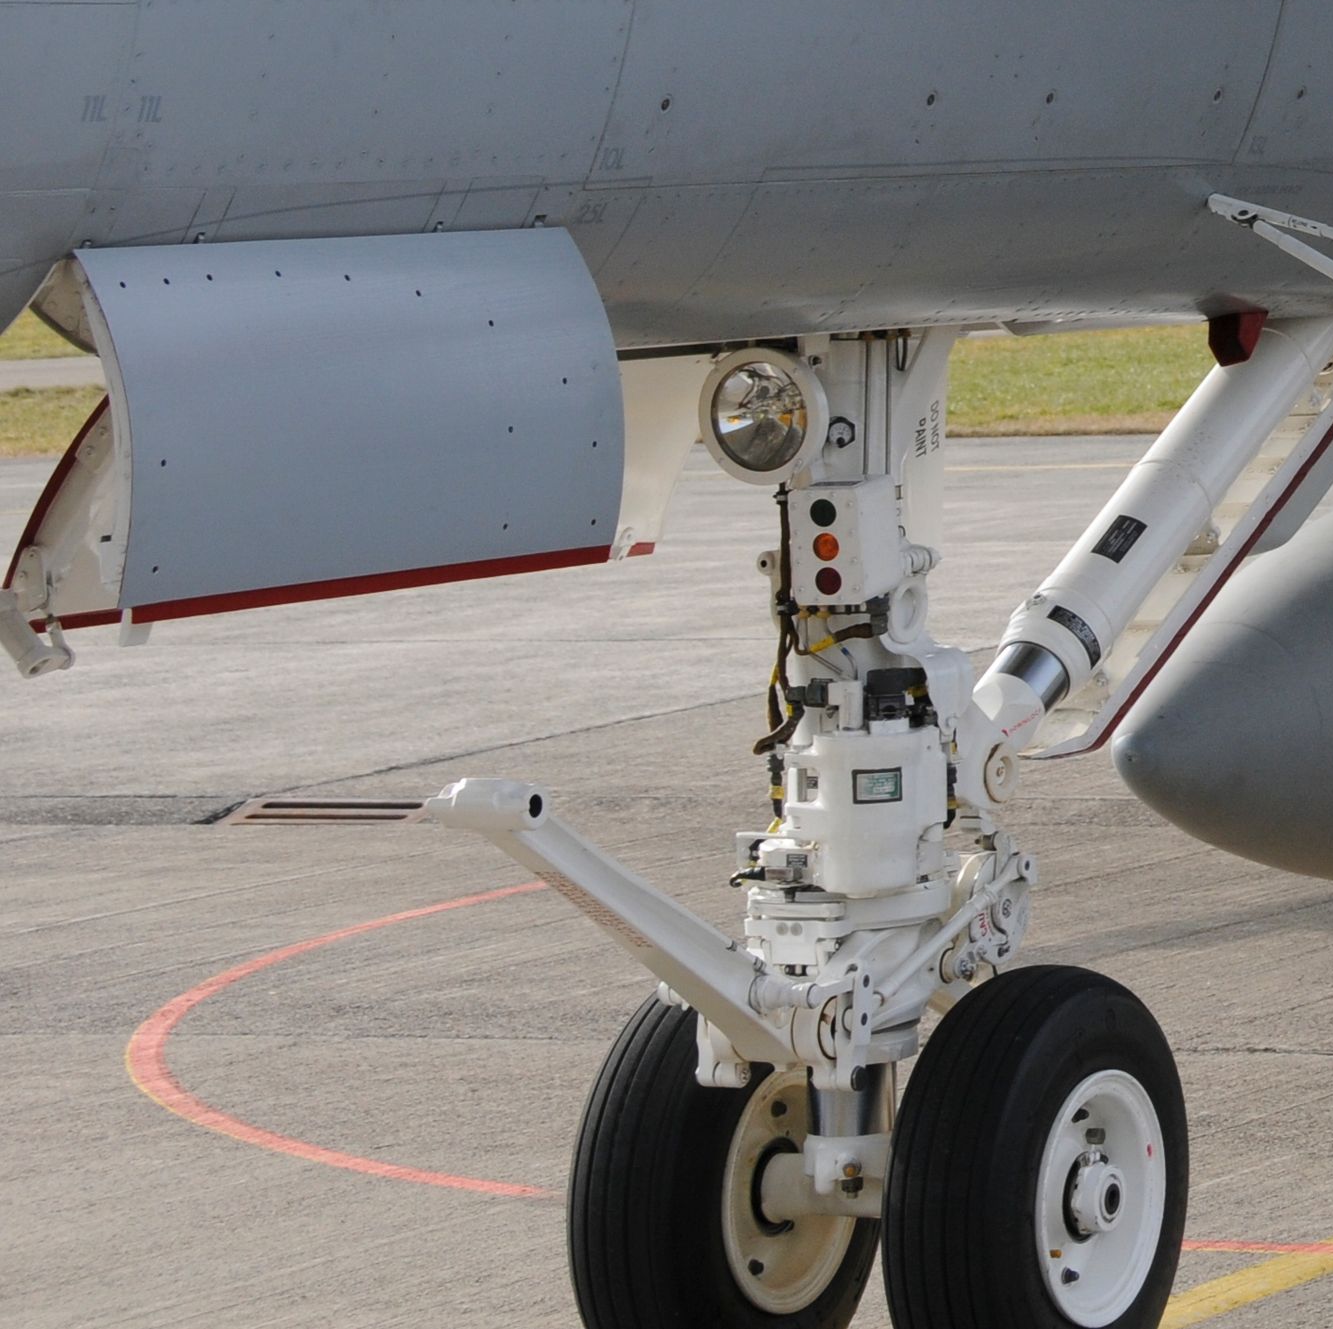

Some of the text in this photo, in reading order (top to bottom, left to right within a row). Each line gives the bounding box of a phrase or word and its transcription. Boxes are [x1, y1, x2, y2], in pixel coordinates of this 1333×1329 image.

[81, 94, 107, 122] 11L
[137, 94, 162, 123] 11L
[915, 416, 927, 458] PAINT
[930, 400, 940, 452] DO NOT
